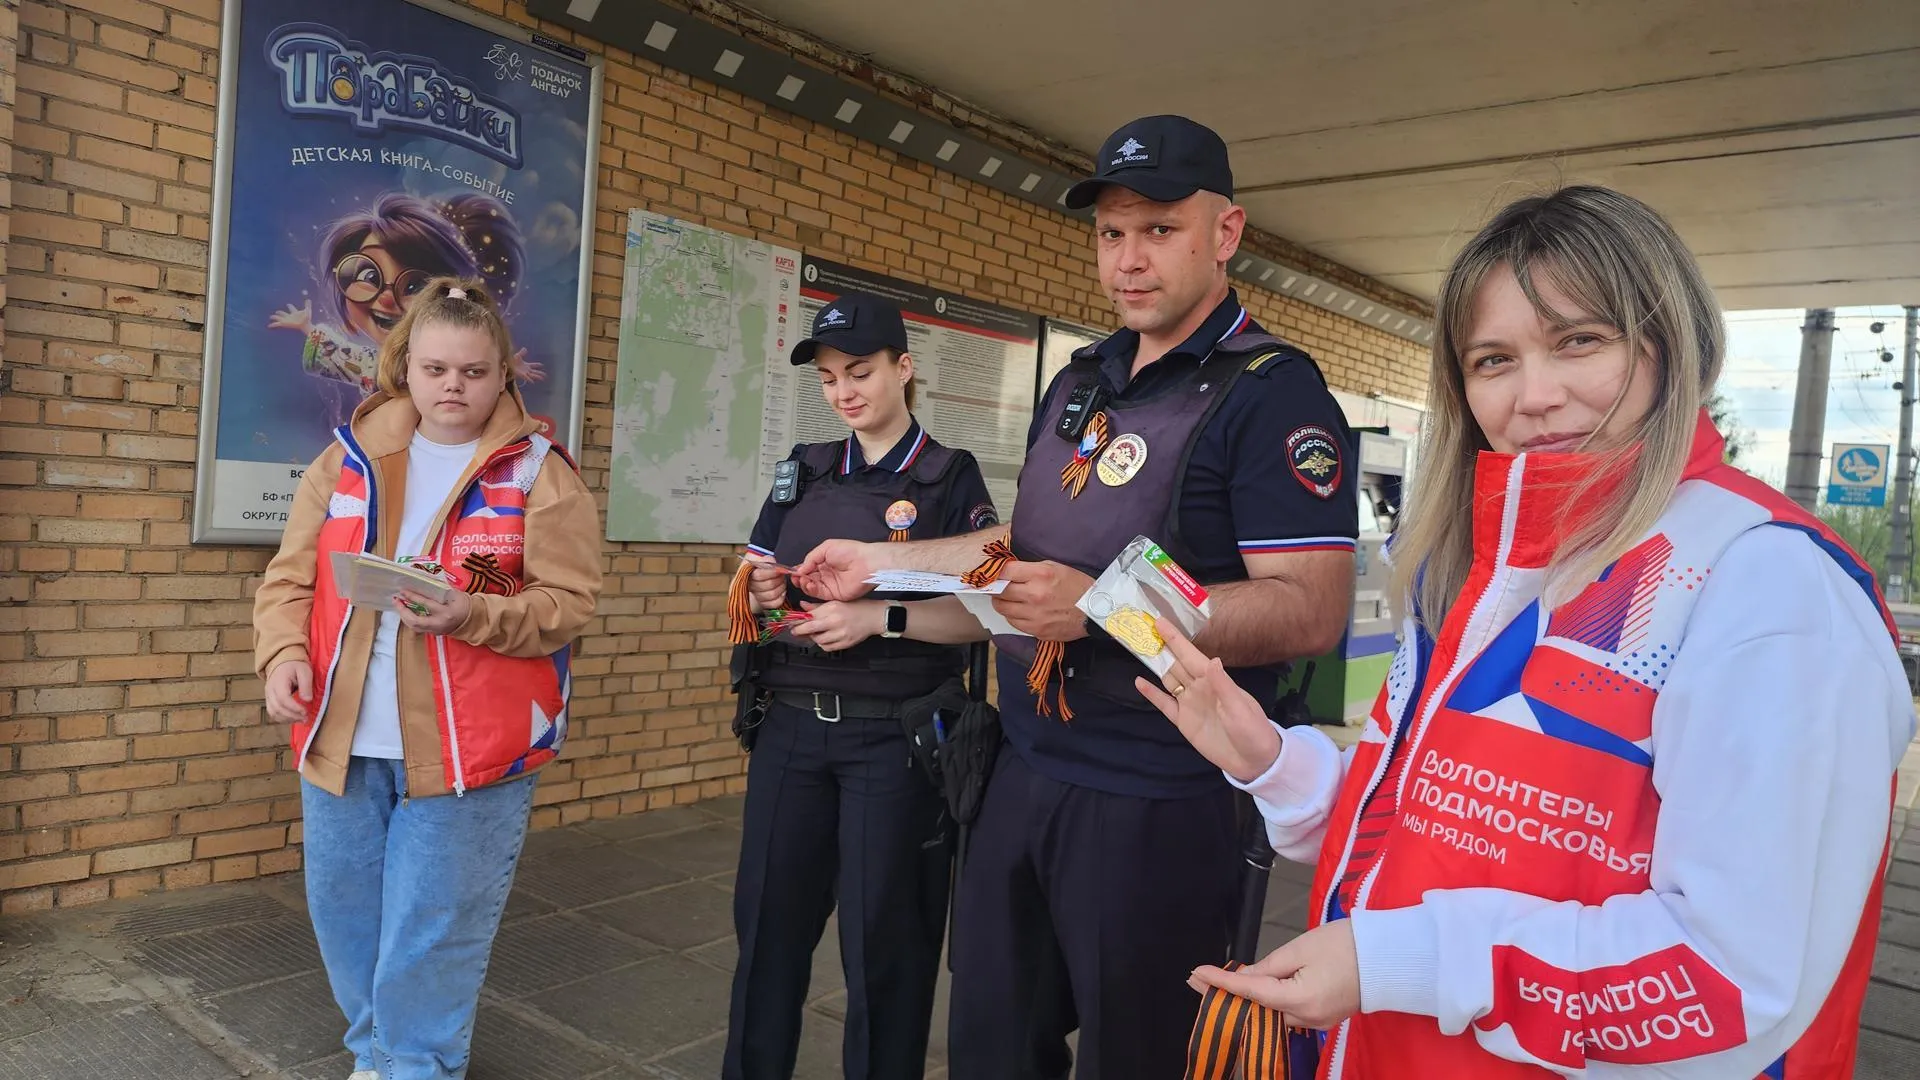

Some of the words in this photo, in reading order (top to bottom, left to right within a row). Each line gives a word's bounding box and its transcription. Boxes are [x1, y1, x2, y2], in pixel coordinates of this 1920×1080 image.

[531, 65, 582, 91] ПОДАРОК
[531, 78, 570, 98] АНГЕЛУ
[291, 147, 373, 165] ДЕТСКАЯ
[381, 150, 516, 205] КНИГА-СОБЫТИЕ
[775, 256, 795, 268] КАРТА
[262, 492, 278, 502] БФ
[242, 511, 278, 521] ОКРУГ
[451, 545, 523, 557] ПОДМОСКО
[1420, 749, 1615, 831] ВОЛОНТЕРЫ
[1411, 777, 1651, 876] ПОДМОСКОВЬЯ
[1402, 812, 1428, 836] МЫ
[1430, 822, 1507, 865] РЯДОМ
